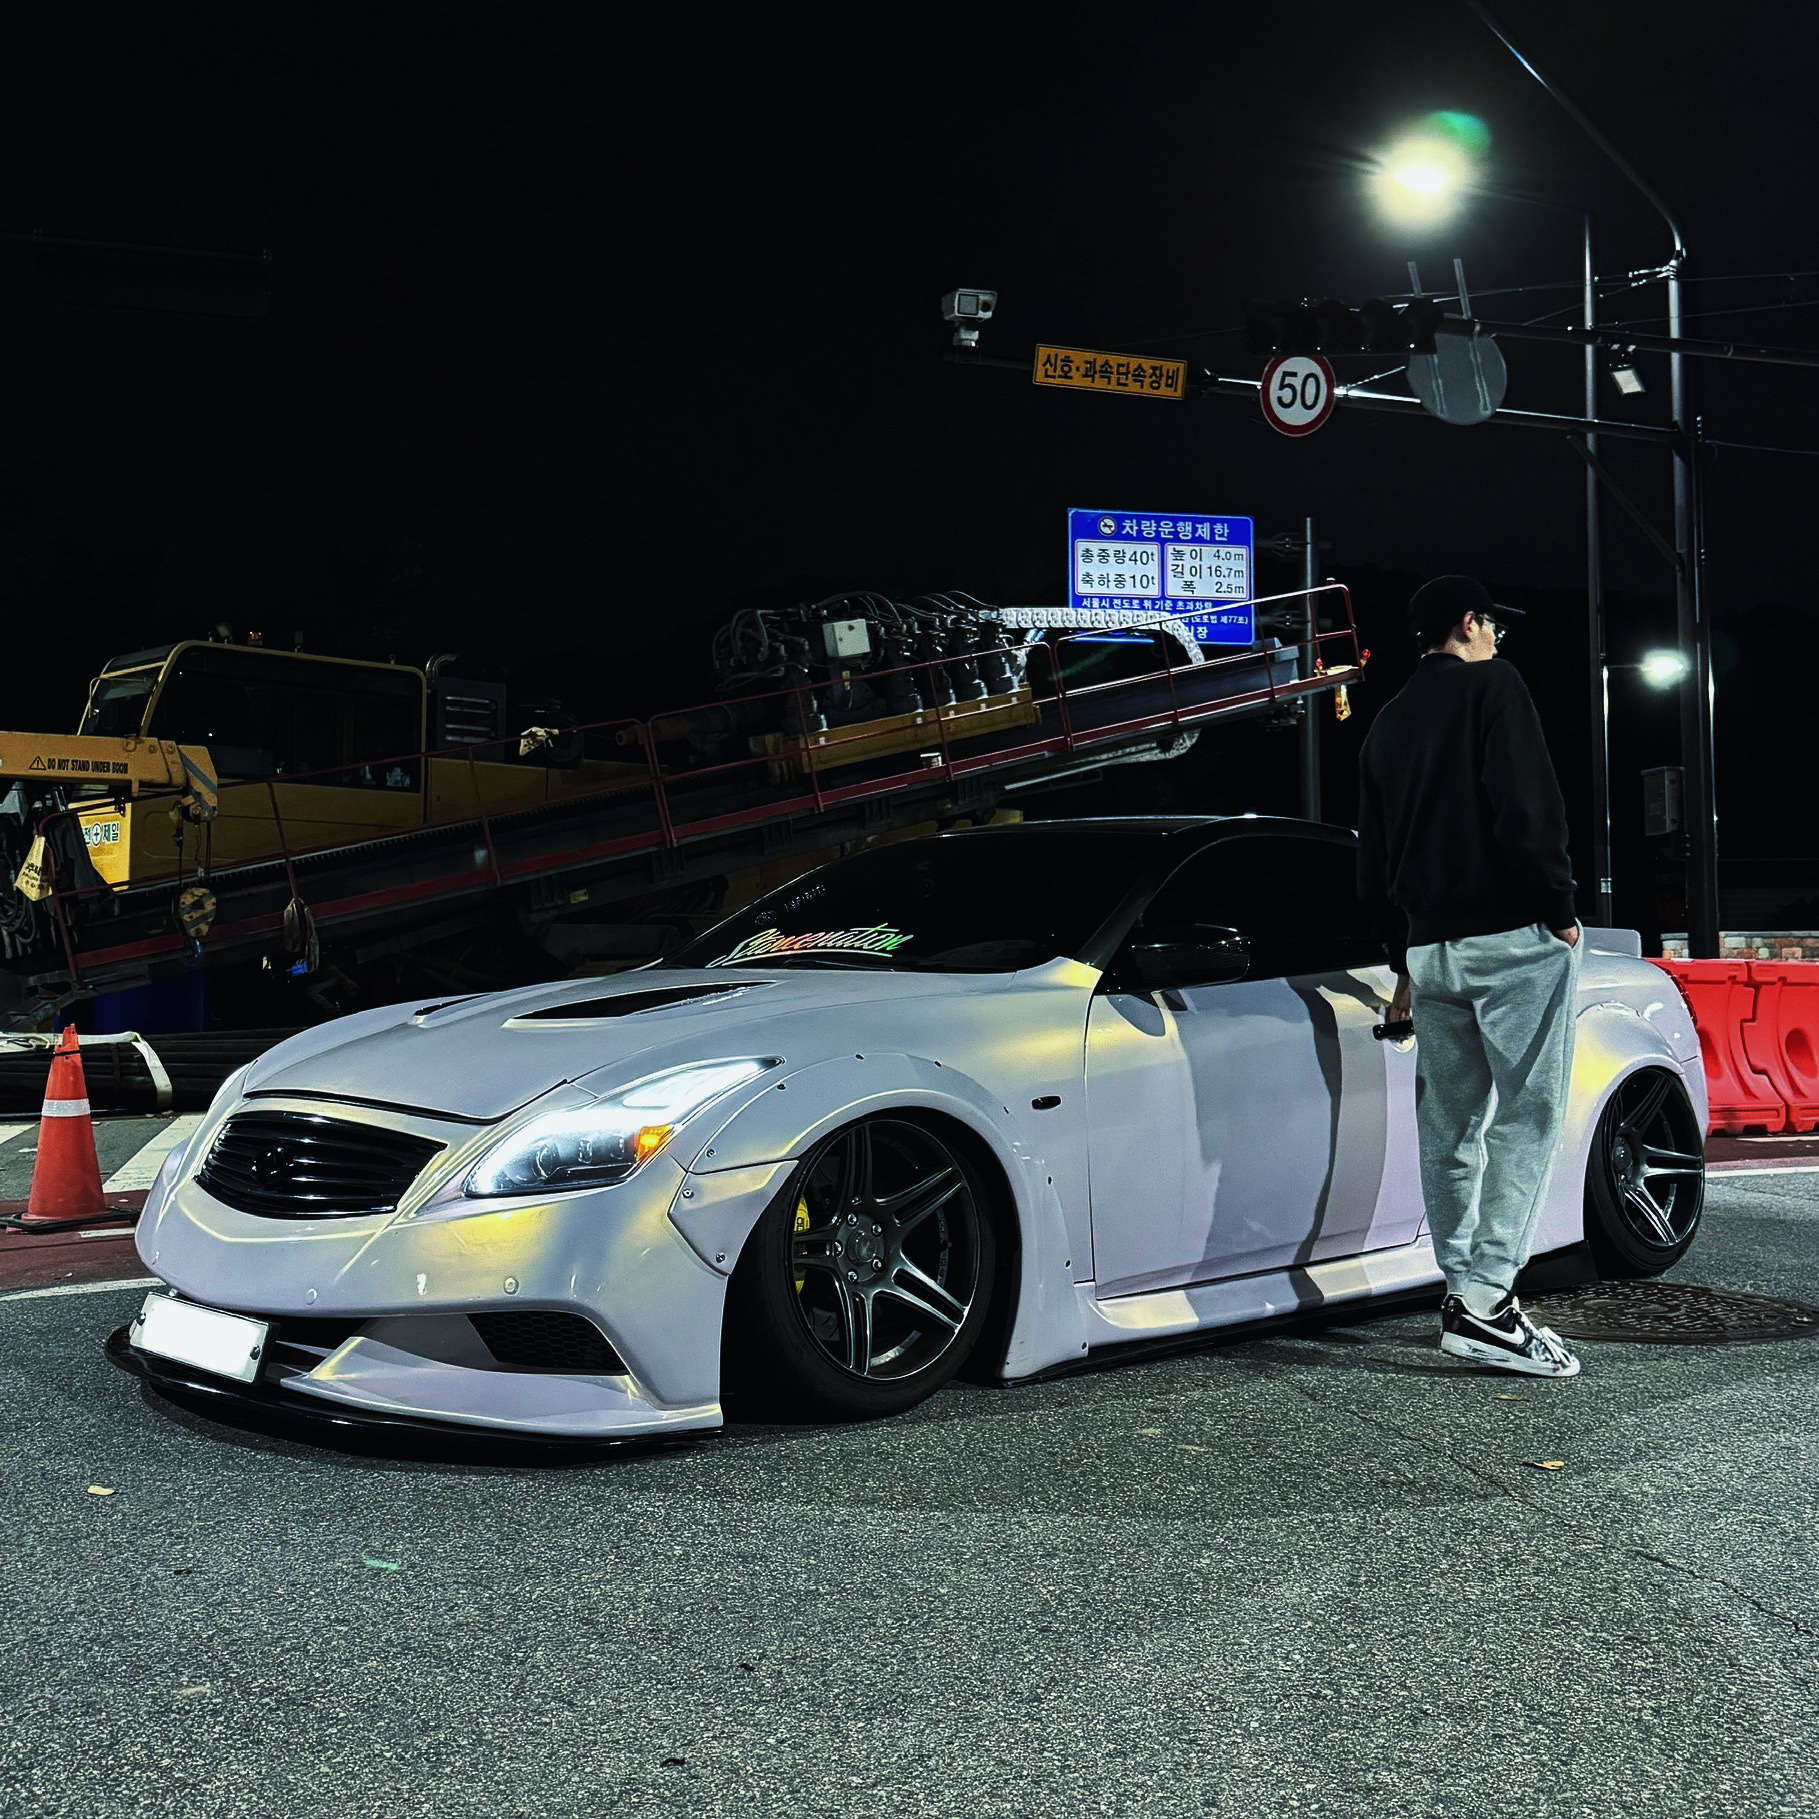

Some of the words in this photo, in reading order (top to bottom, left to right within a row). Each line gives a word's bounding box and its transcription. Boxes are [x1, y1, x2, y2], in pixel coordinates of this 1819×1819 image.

[1041, 352, 1180, 393] 신호·과속단속장비
[1276, 371, 1321, 411] 50
[1121, 518, 1230, 541] 차량운행제한
[1207, 565, 1244, 579] 16.7m
[1180, 580, 1197, 595] 폭
[1214, 581, 1245, 595] 2.5m
[47, 757, 57, 770] DO
[57, 758, 70, 771] NOT
[71, 759, 91, 773] STAND
[91, 760, 111, 774] UNDER
[111, 761, 129, 775] BOOM
